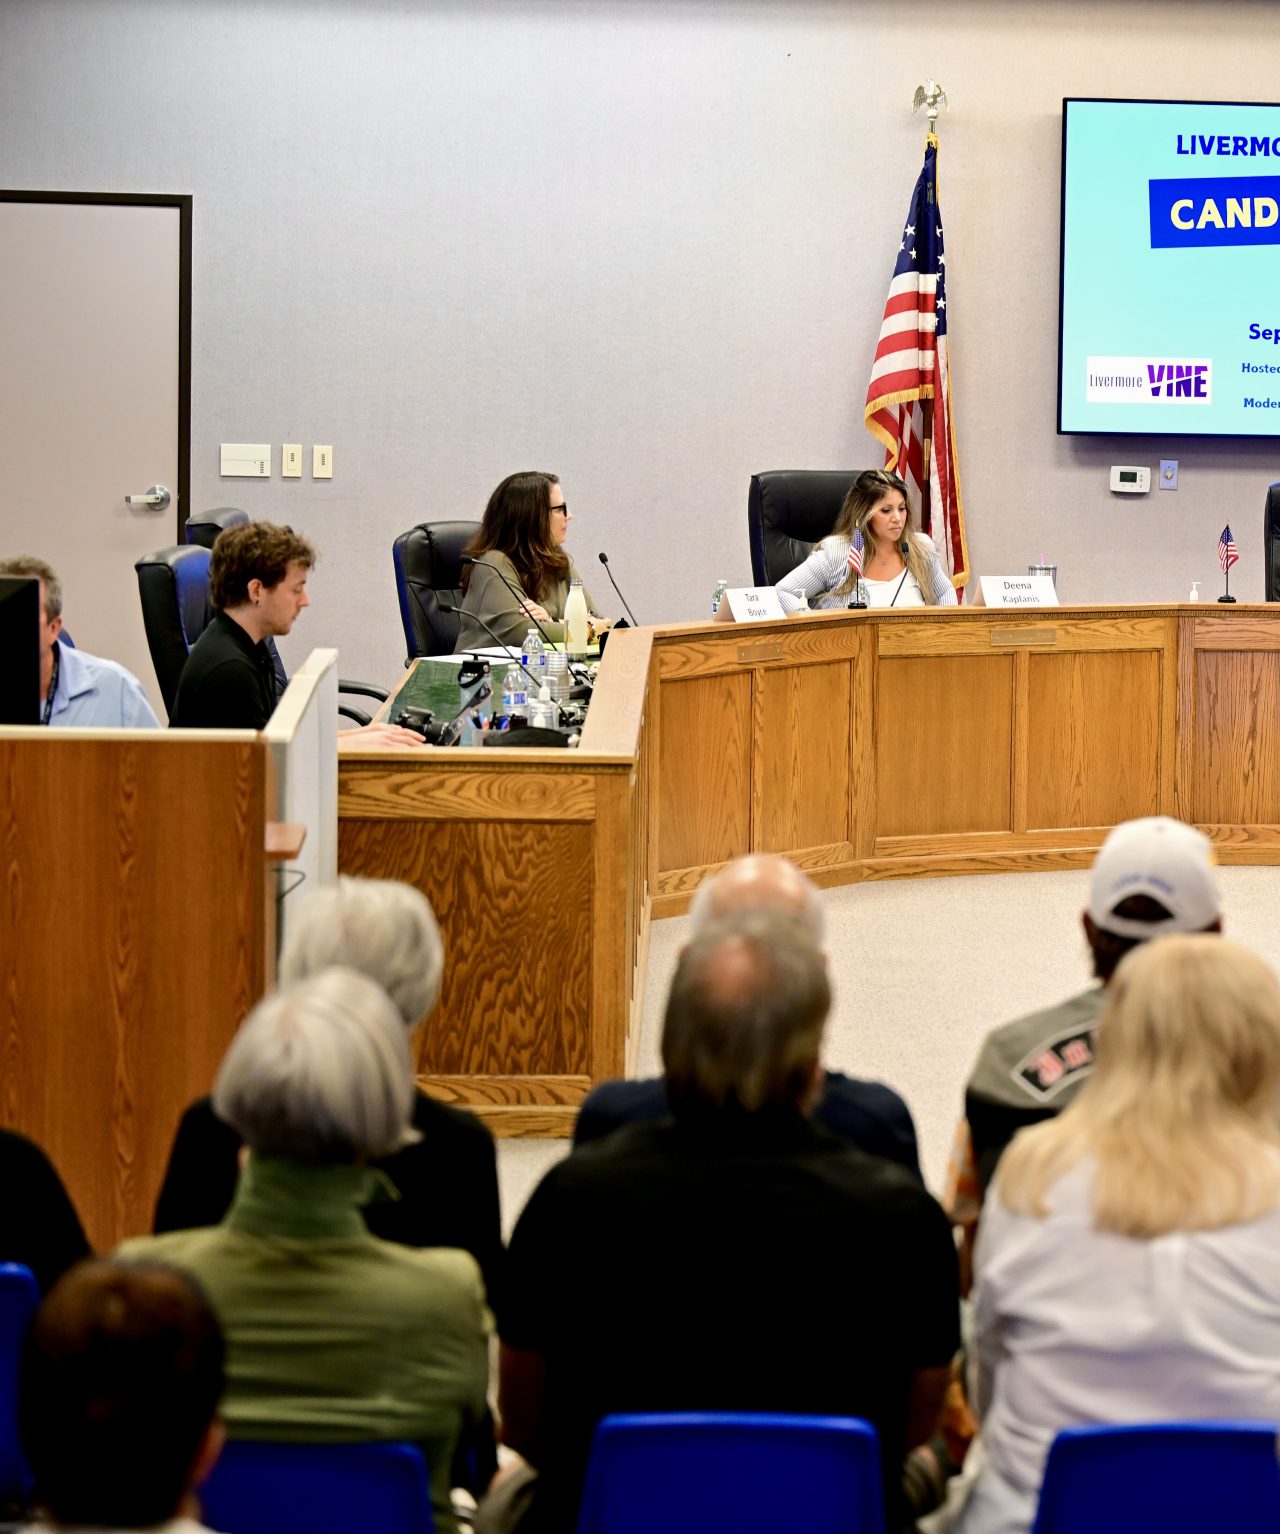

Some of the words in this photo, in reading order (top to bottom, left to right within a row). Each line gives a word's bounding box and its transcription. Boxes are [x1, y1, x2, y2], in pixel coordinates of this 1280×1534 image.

[1090, 374, 1143, 388] Livermore
[1147, 364, 1208, 398] VINE
[1003, 581, 1032, 590] Deena
[744, 593, 760, 602] Tara
[1002, 594, 1040, 604] Kaplanis
